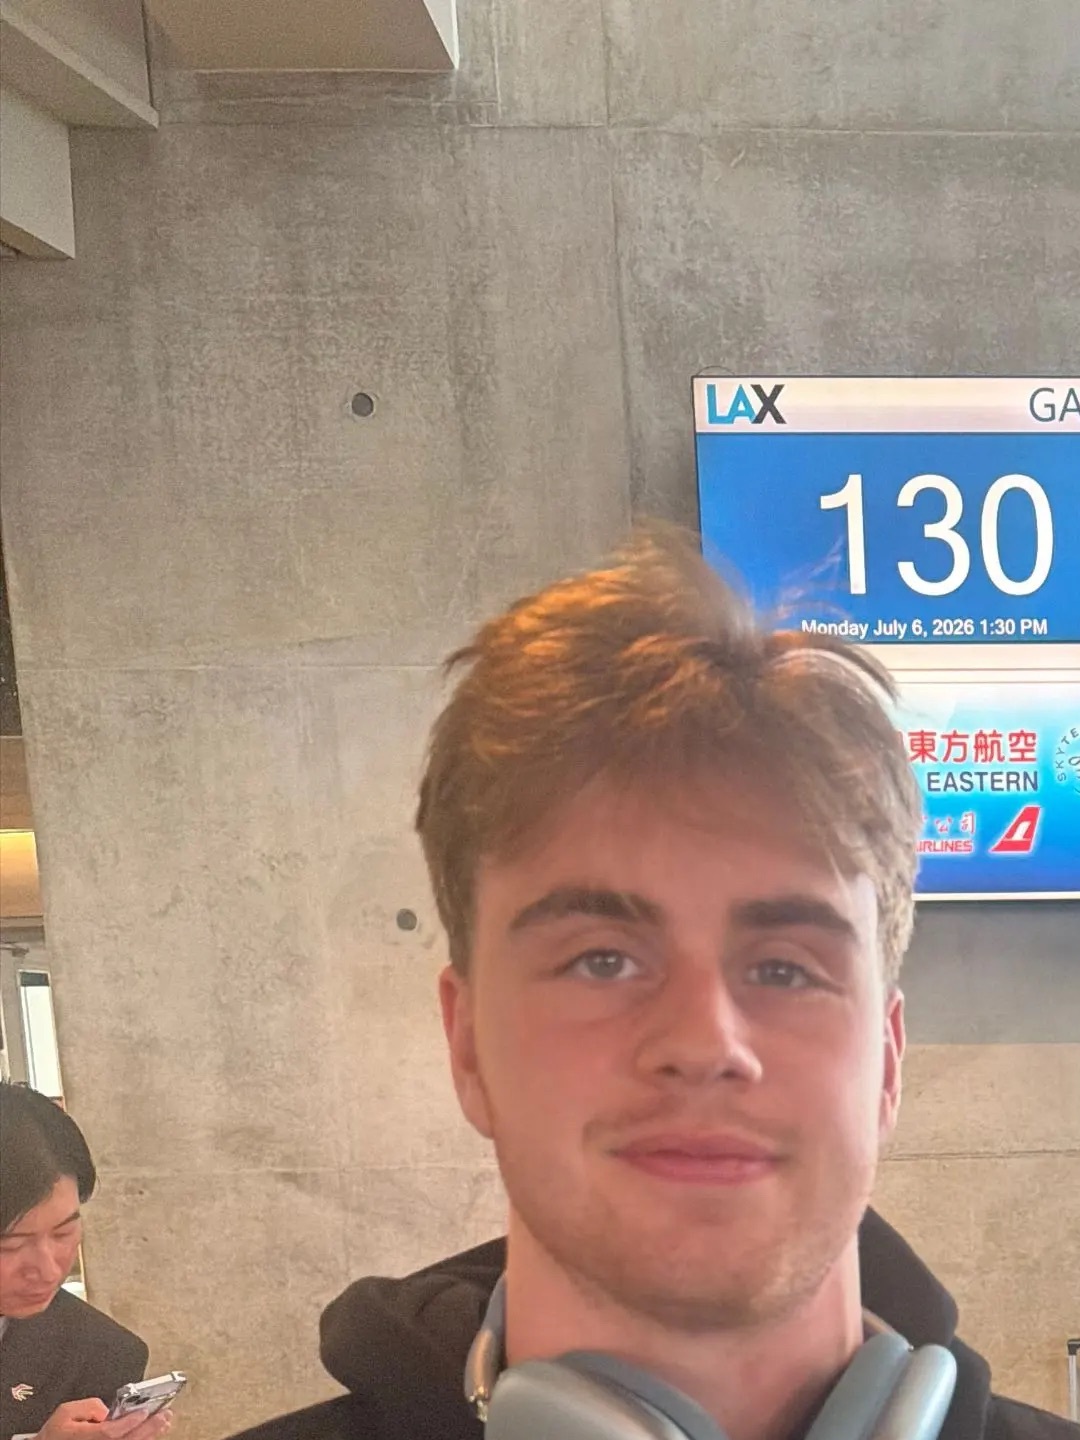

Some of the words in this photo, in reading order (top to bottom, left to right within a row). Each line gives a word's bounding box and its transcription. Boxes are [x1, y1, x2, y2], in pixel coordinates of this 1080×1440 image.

[706, 384, 788, 425] LAX
[819, 473, 1054, 596] 130
[801, 618, 869, 640] Monday
[873, 619, 907, 640] July
[911, 618, 928, 638] 6,
[932, 618, 975, 636] 2026
[979, 618, 1016, 636] 1:30
[1020, 618, 1048, 635] PM
[907, 730, 1037, 763] 東方航空
[926, 770, 1039, 792] EASTERN
[921, 812, 975, 834] 公司
[917, 840, 973, 853] IRLINES
